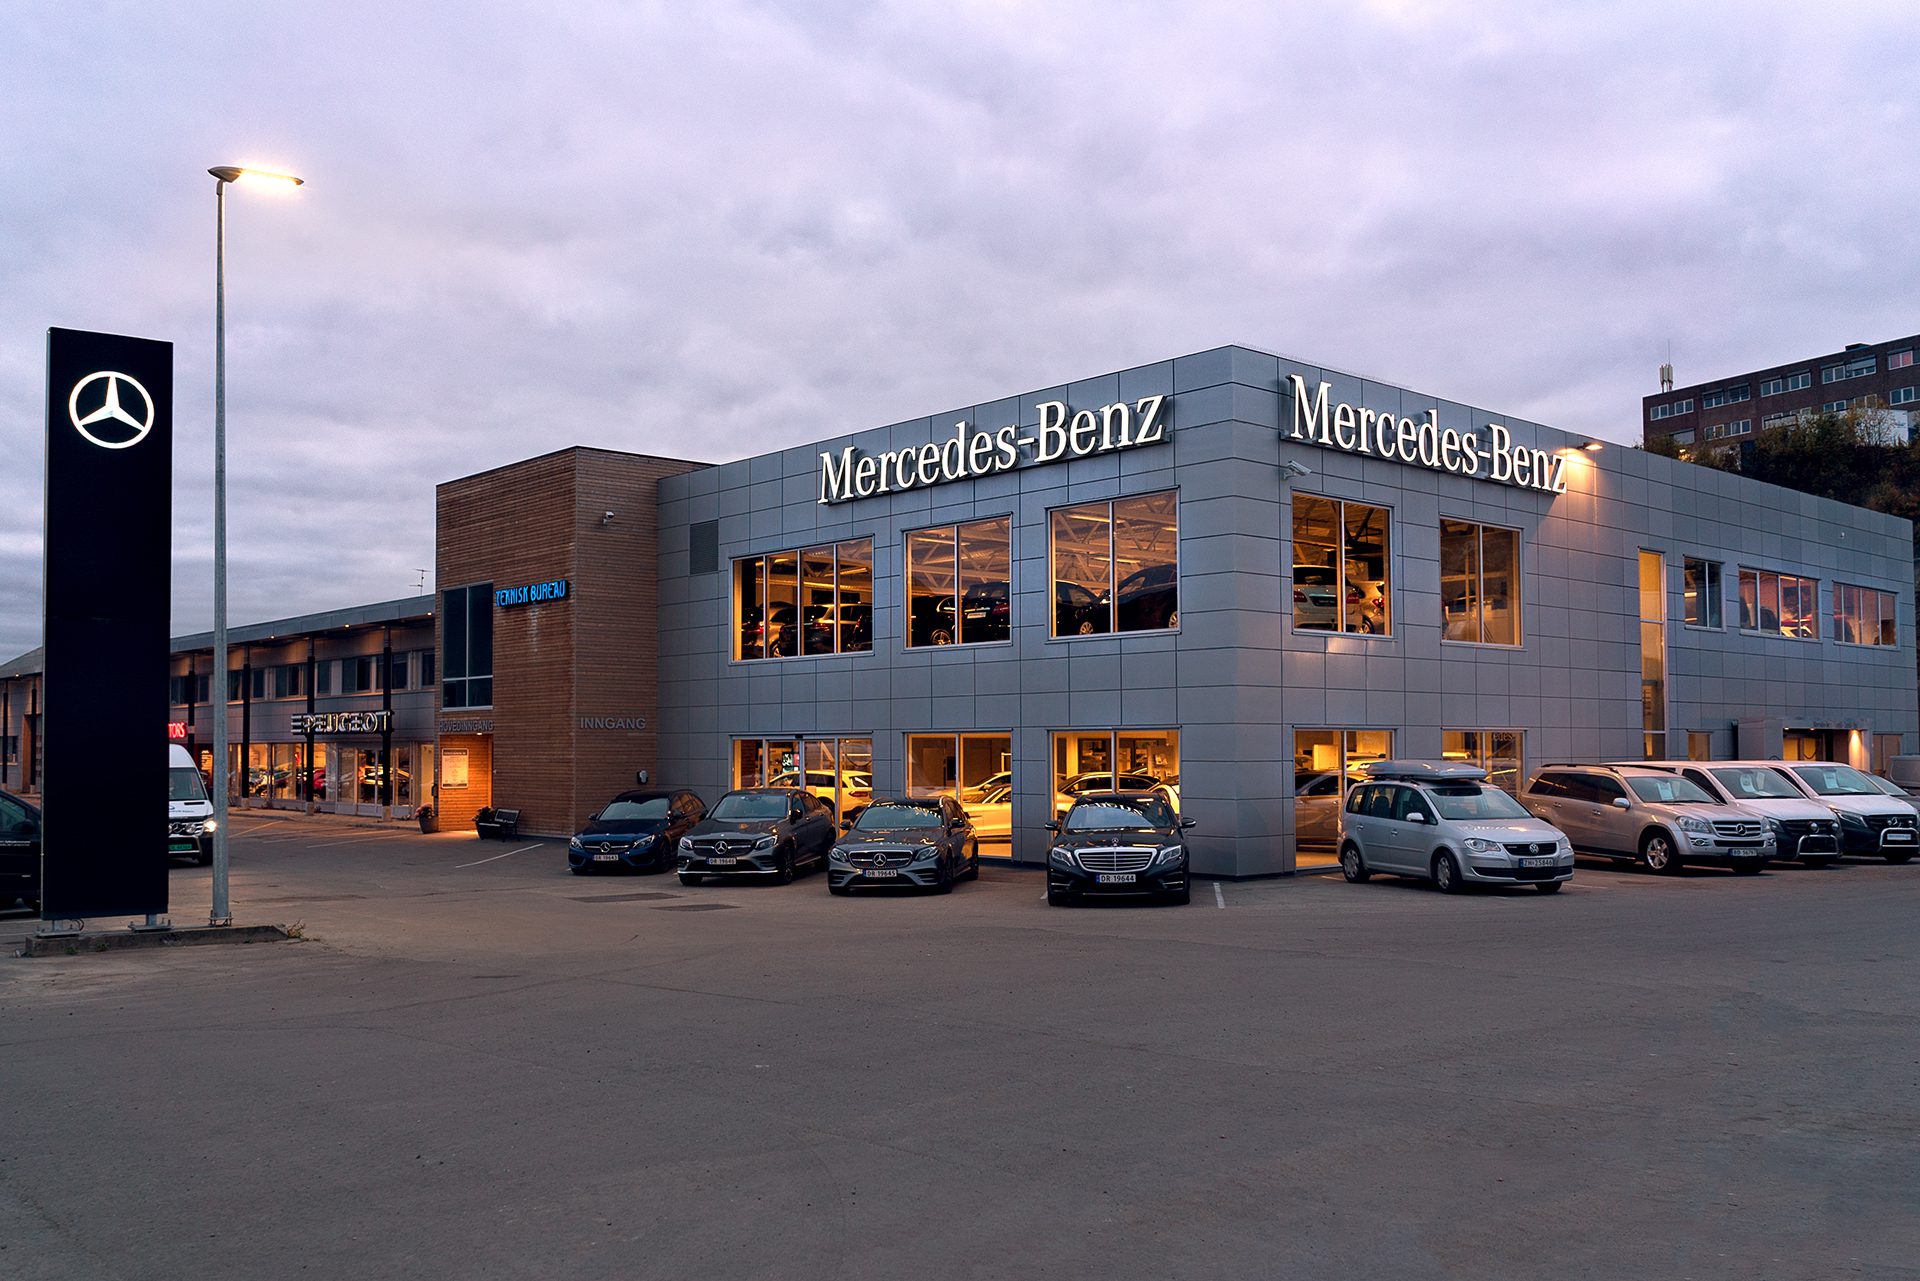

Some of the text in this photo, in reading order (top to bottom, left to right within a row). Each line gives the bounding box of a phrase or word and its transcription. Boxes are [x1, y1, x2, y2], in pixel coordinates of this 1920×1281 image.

[1290, 374, 1567, 494] Mercedes-Benz
[818, 394, 1166, 504] Mercedes-Benz
[495, 580, 566, 607] TEKNISK BUREAU
[302, 711, 390, 733] PEUGEOT
[580, 717, 647, 730] INNGANG
